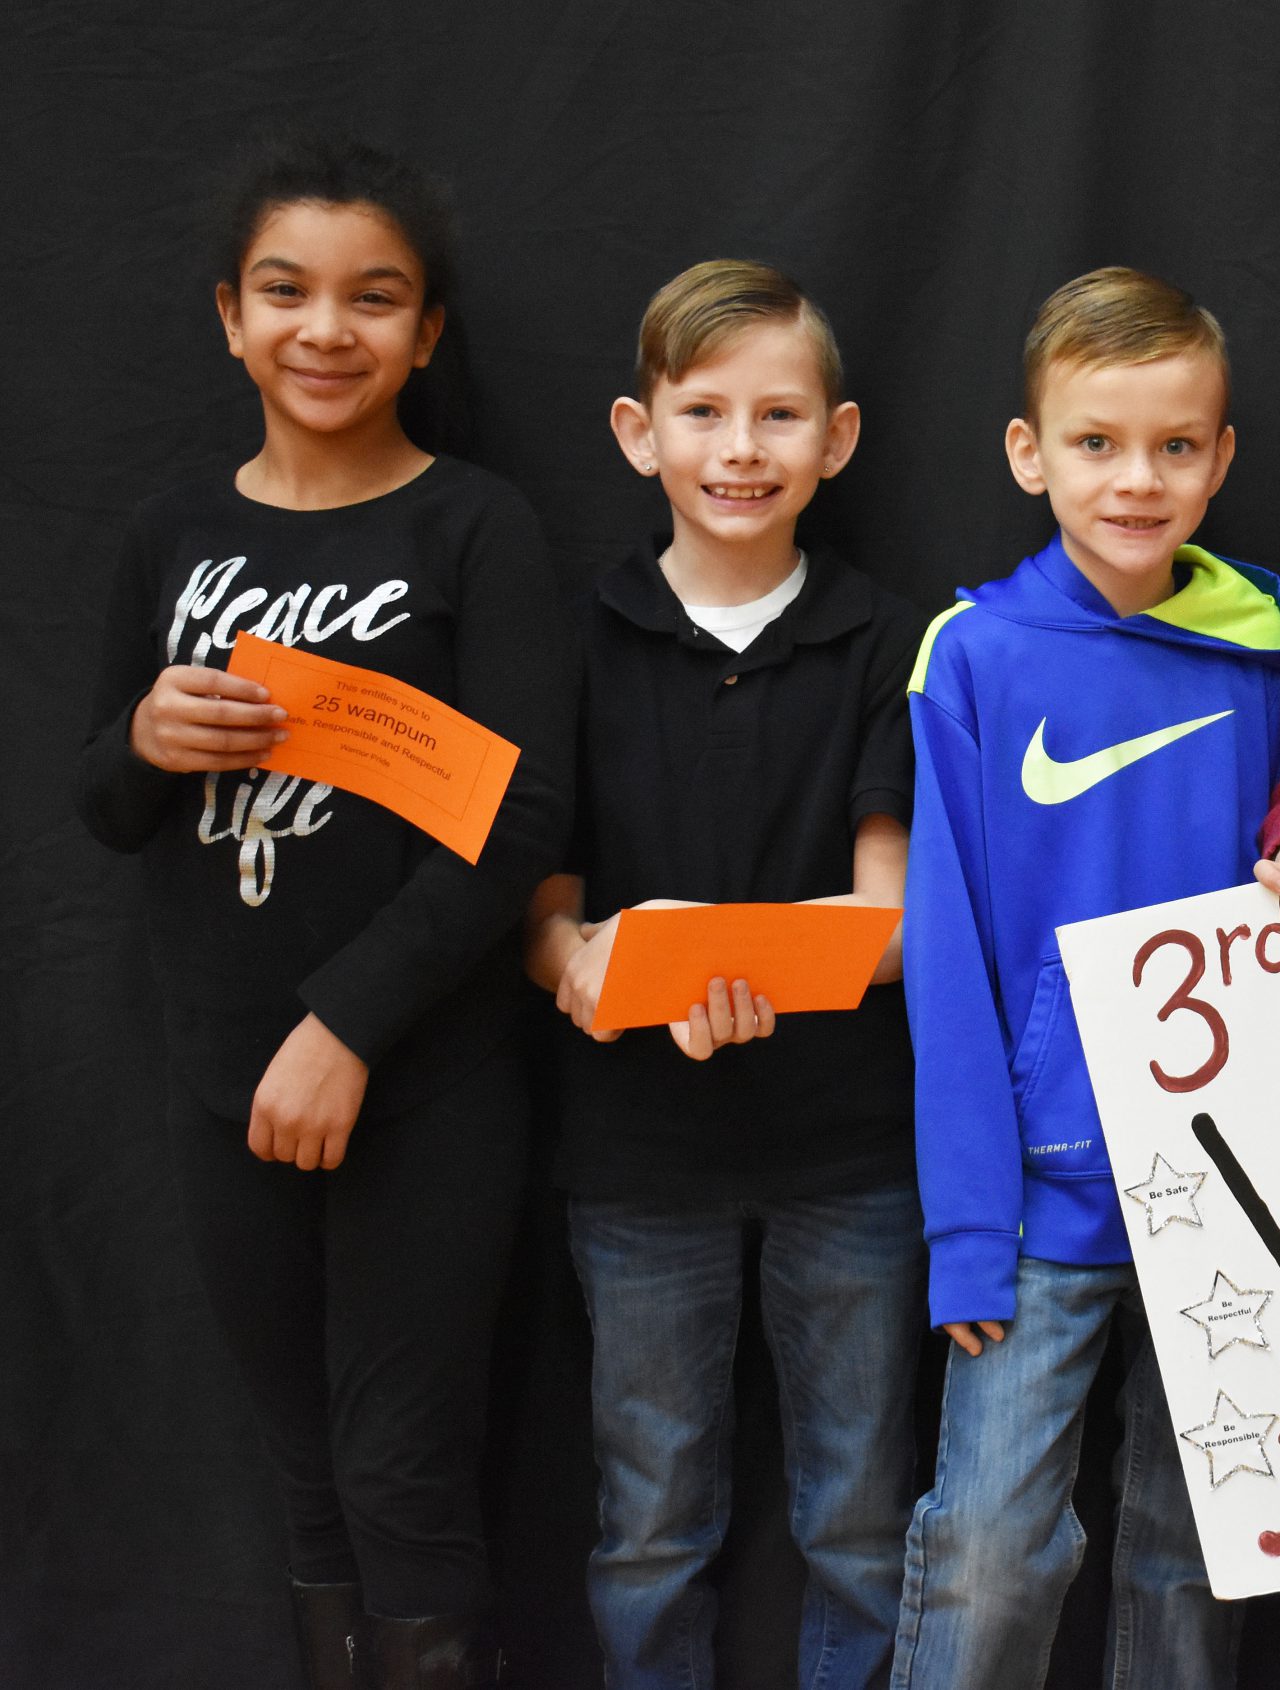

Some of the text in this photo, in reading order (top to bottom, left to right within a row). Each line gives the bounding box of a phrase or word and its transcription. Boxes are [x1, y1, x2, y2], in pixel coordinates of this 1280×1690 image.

[167, 556, 411, 663] Peace
[337, 681, 431, 722] This entitles you to
[312, 694, 437, 751] 25 wampum
[313, 718, 379, 743] Responsible
[380, 738, 401, 753] and
[402, 748, 452, 782] Respectful
[1028, 1139, 1092, 1155] THERMA-FIT
[1149, 1185, 1189, 1200] Be Safe
[1222, 1300, 1233, 1308] Be
[1207, 1307, 1252, 1323] Respectful
[1223, 1424, 1236, 1433] Be
[1204, 1431, 1260, 1449] Responsible
